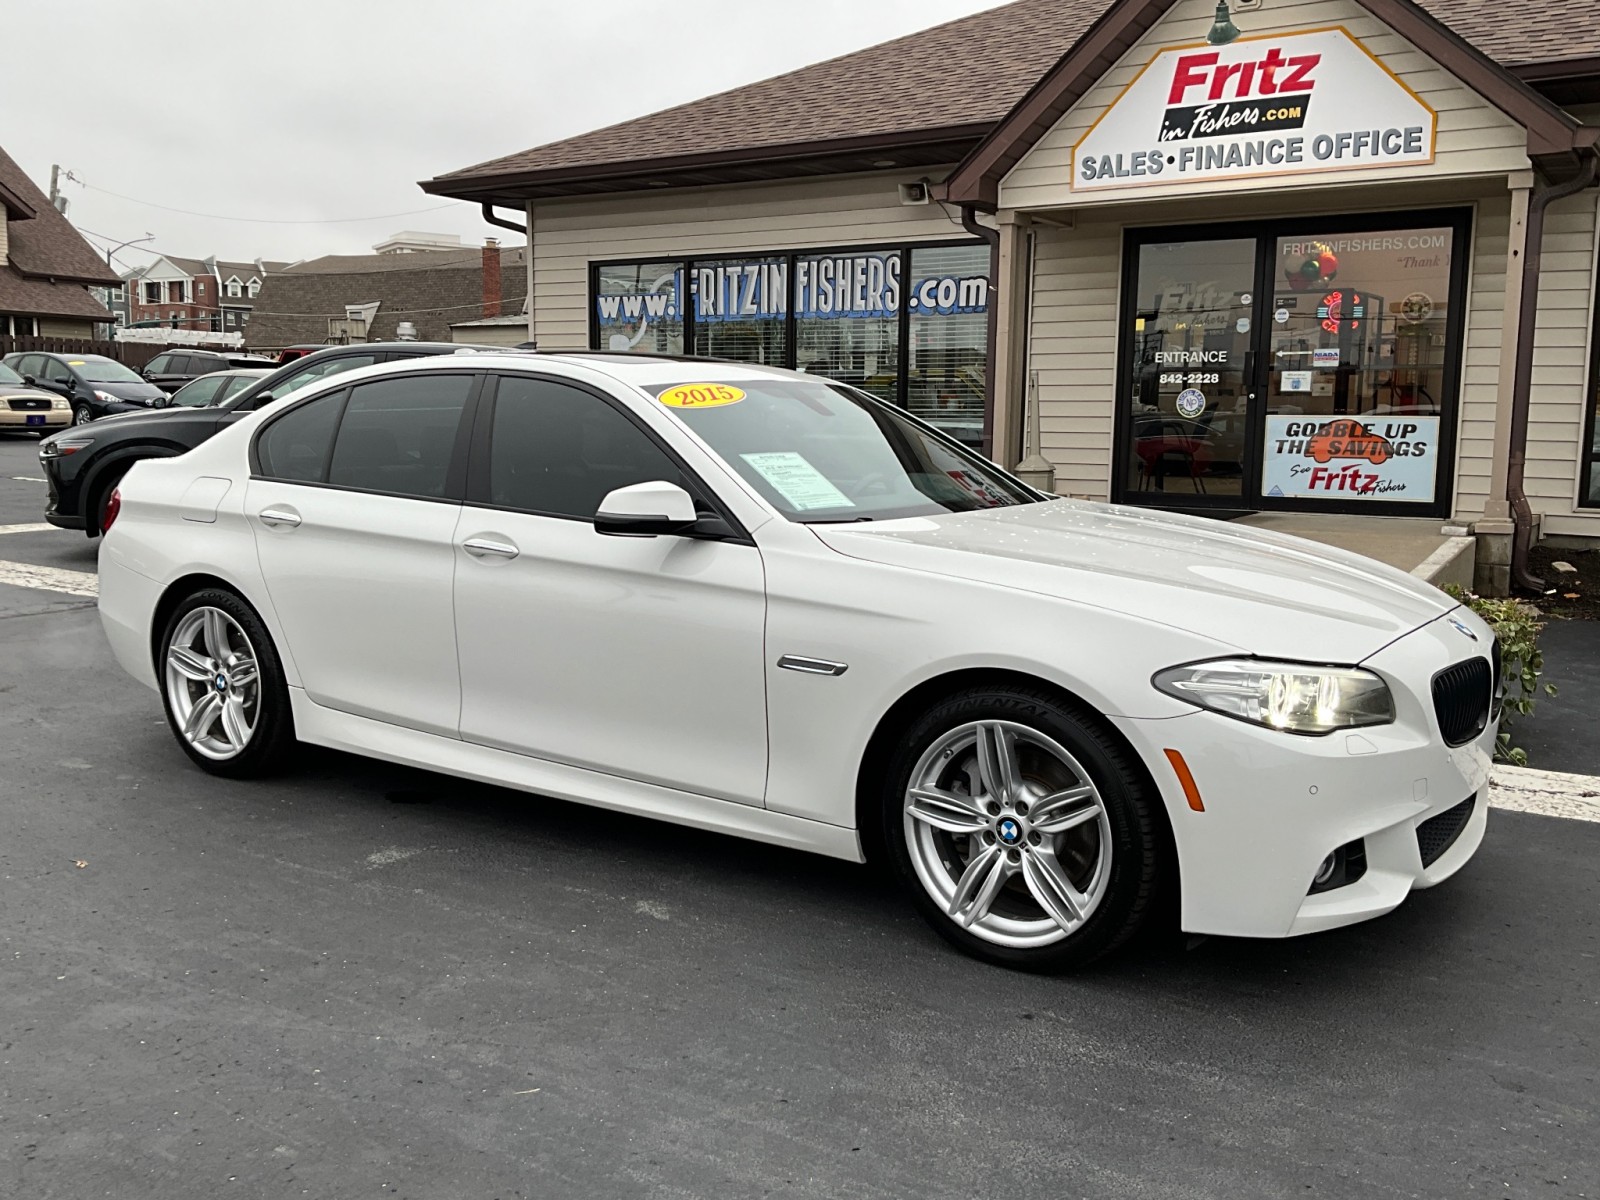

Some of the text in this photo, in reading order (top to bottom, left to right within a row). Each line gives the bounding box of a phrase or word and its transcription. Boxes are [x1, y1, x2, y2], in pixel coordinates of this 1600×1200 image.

[1167, 47, 1322, 105] Fritz
[1161, 121, 1186, 141] in
[1312, 126, 1423, 160] OFFICE
[1282, 235, 1445, 255] FRITZINFISHERS.COM
[1155, 350, 1228, 363] ENTRANCE
[1159, 373, 1219, 384] 842-2228
[674, 386, 734, 405] 2015
[1285, 422, 1417, 439] GOBBLE UP
[1275, 439, 1428, 457] THE SAVINGS
[1290, 463, 1379, 491] See Fritz
[1371, 479, 1407, 496] Fishers
